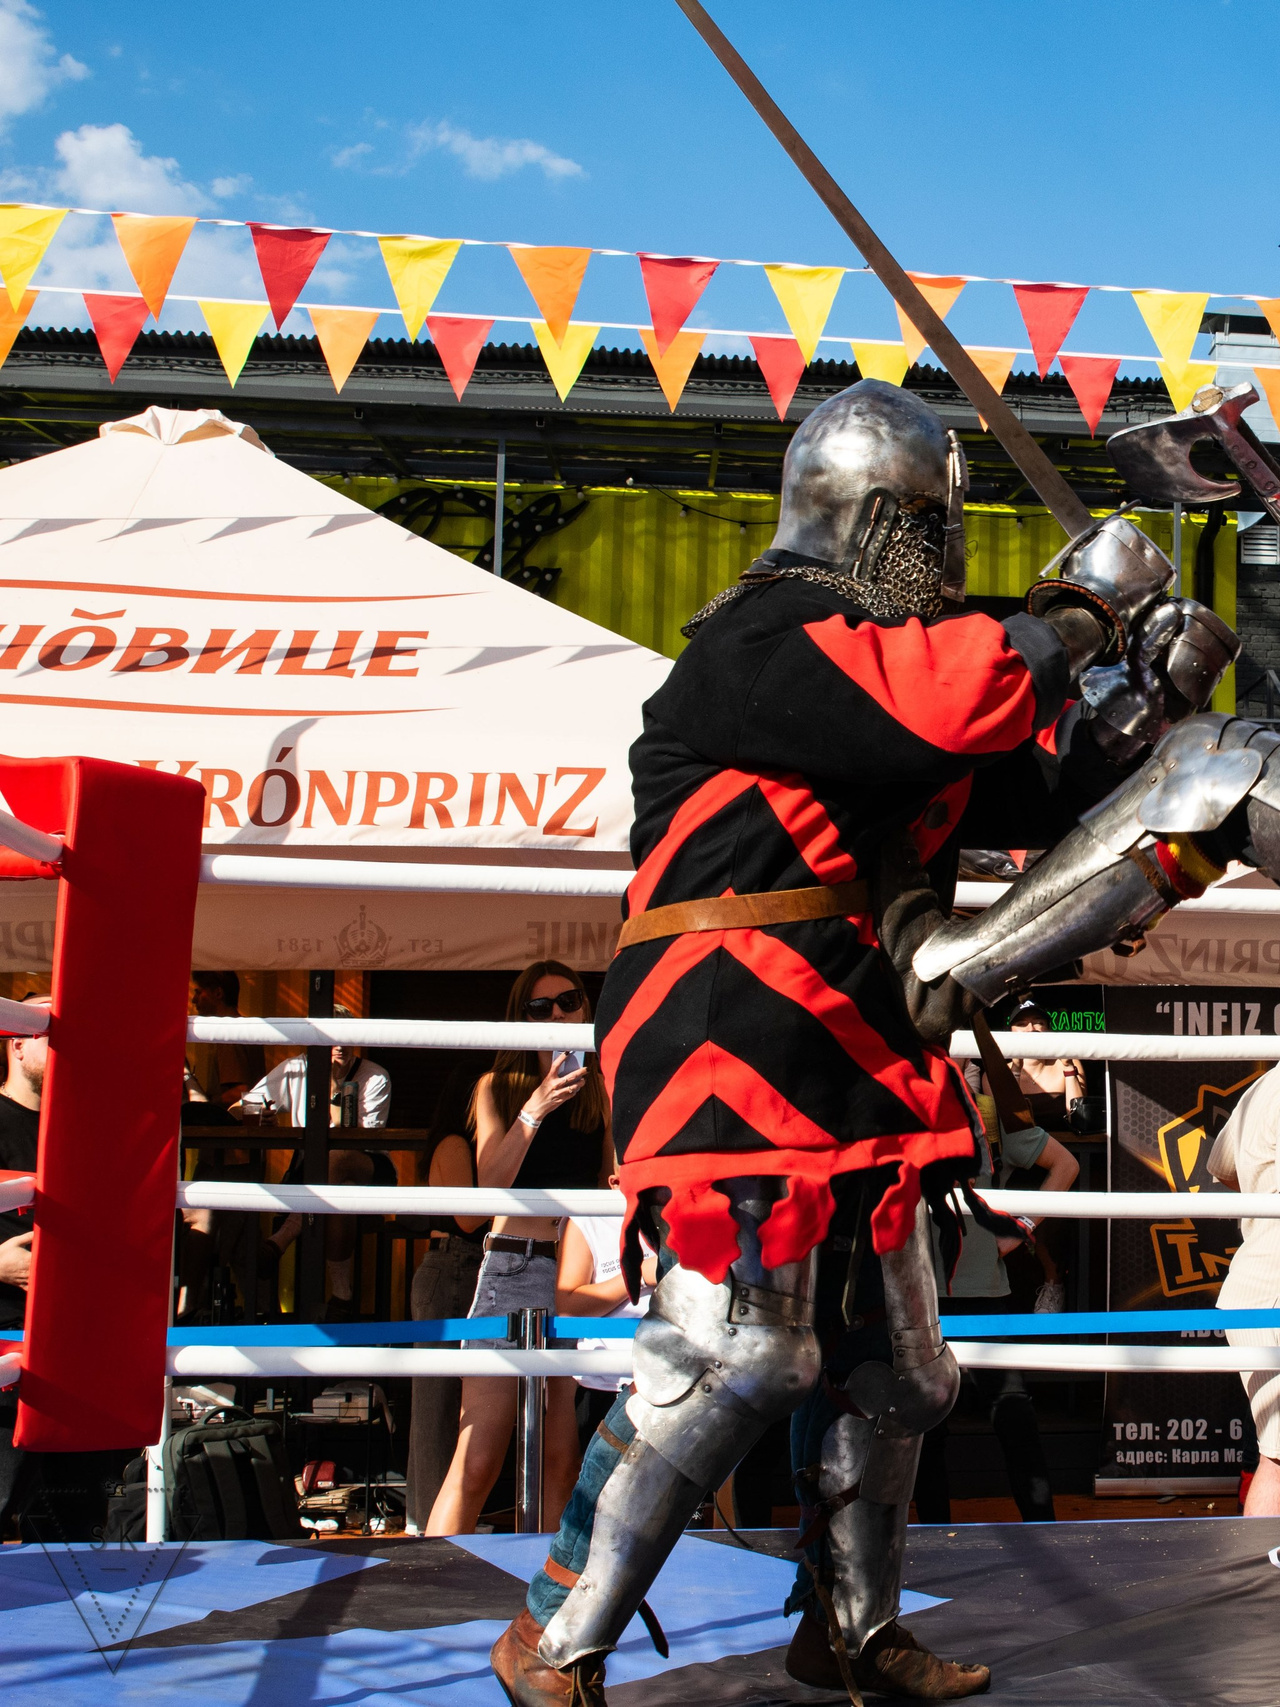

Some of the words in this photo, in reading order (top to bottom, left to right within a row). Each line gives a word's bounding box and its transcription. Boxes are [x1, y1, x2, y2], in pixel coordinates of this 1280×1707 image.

[132, 746, 607, 838] RÓNPRINZ
[1113, 1422, 1160, 1441] тел:
[1167, 1418, 1208, 1441] 202
[1116, 1449, 1168, 1466] адрес:
[1172, 1449, 1220, 1465] Карла
